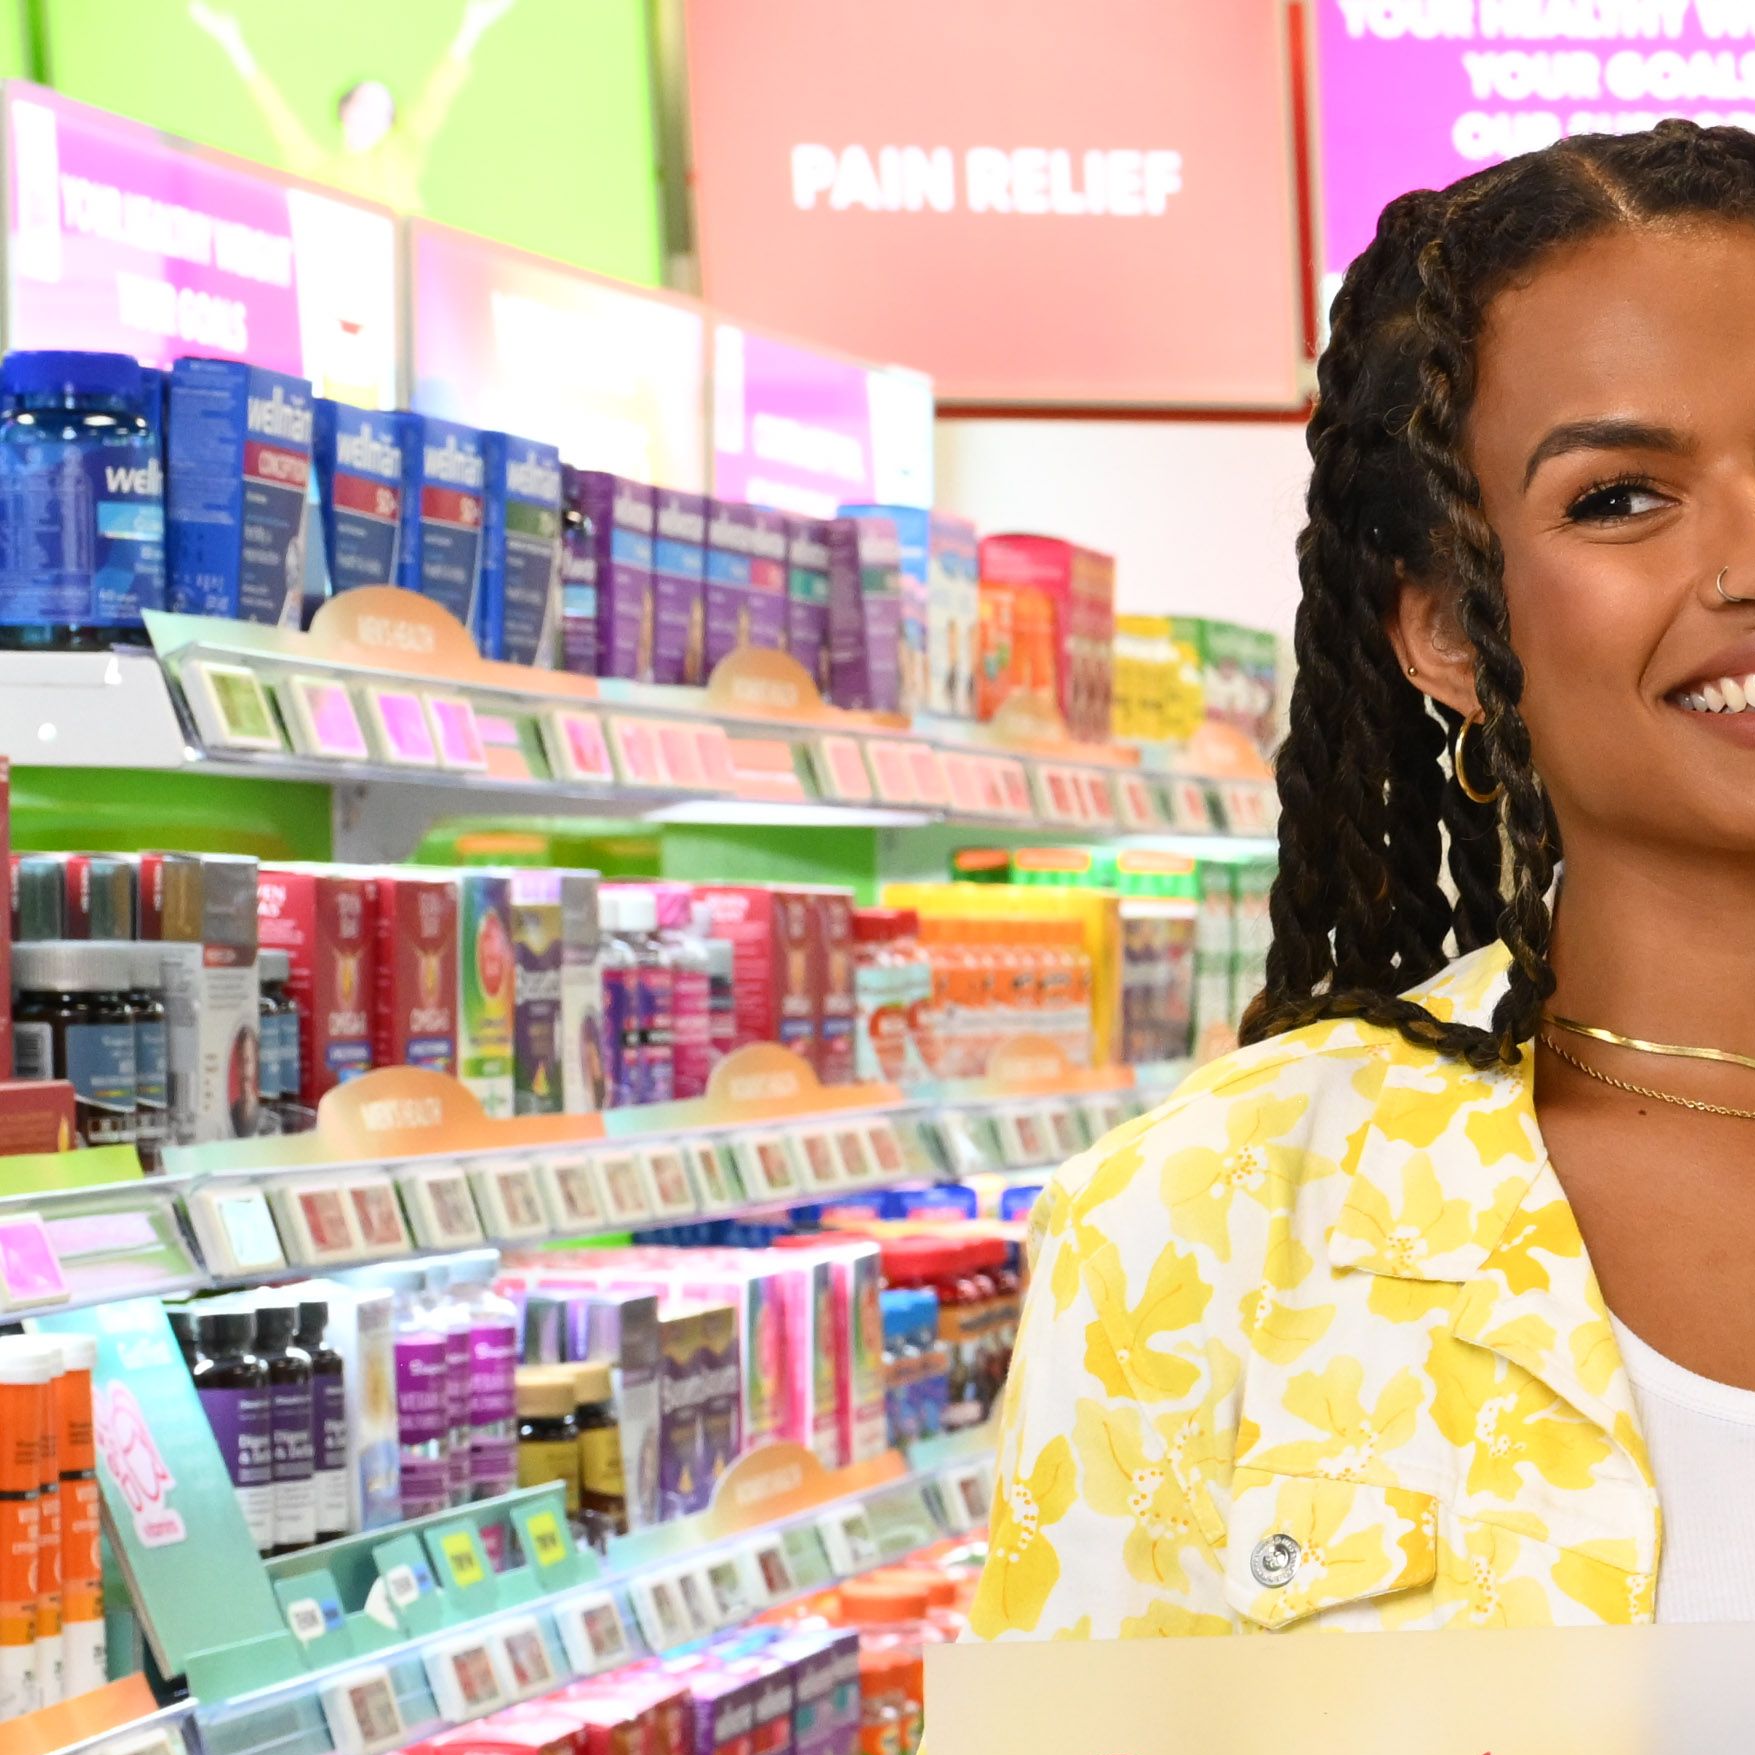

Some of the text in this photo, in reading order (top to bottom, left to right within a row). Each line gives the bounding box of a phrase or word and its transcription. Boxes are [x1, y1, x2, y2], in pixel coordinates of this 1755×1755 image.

[1463, 52, 1598, 100] YOUR
[791, 147, 1180, 217] PAIN RELIEF
